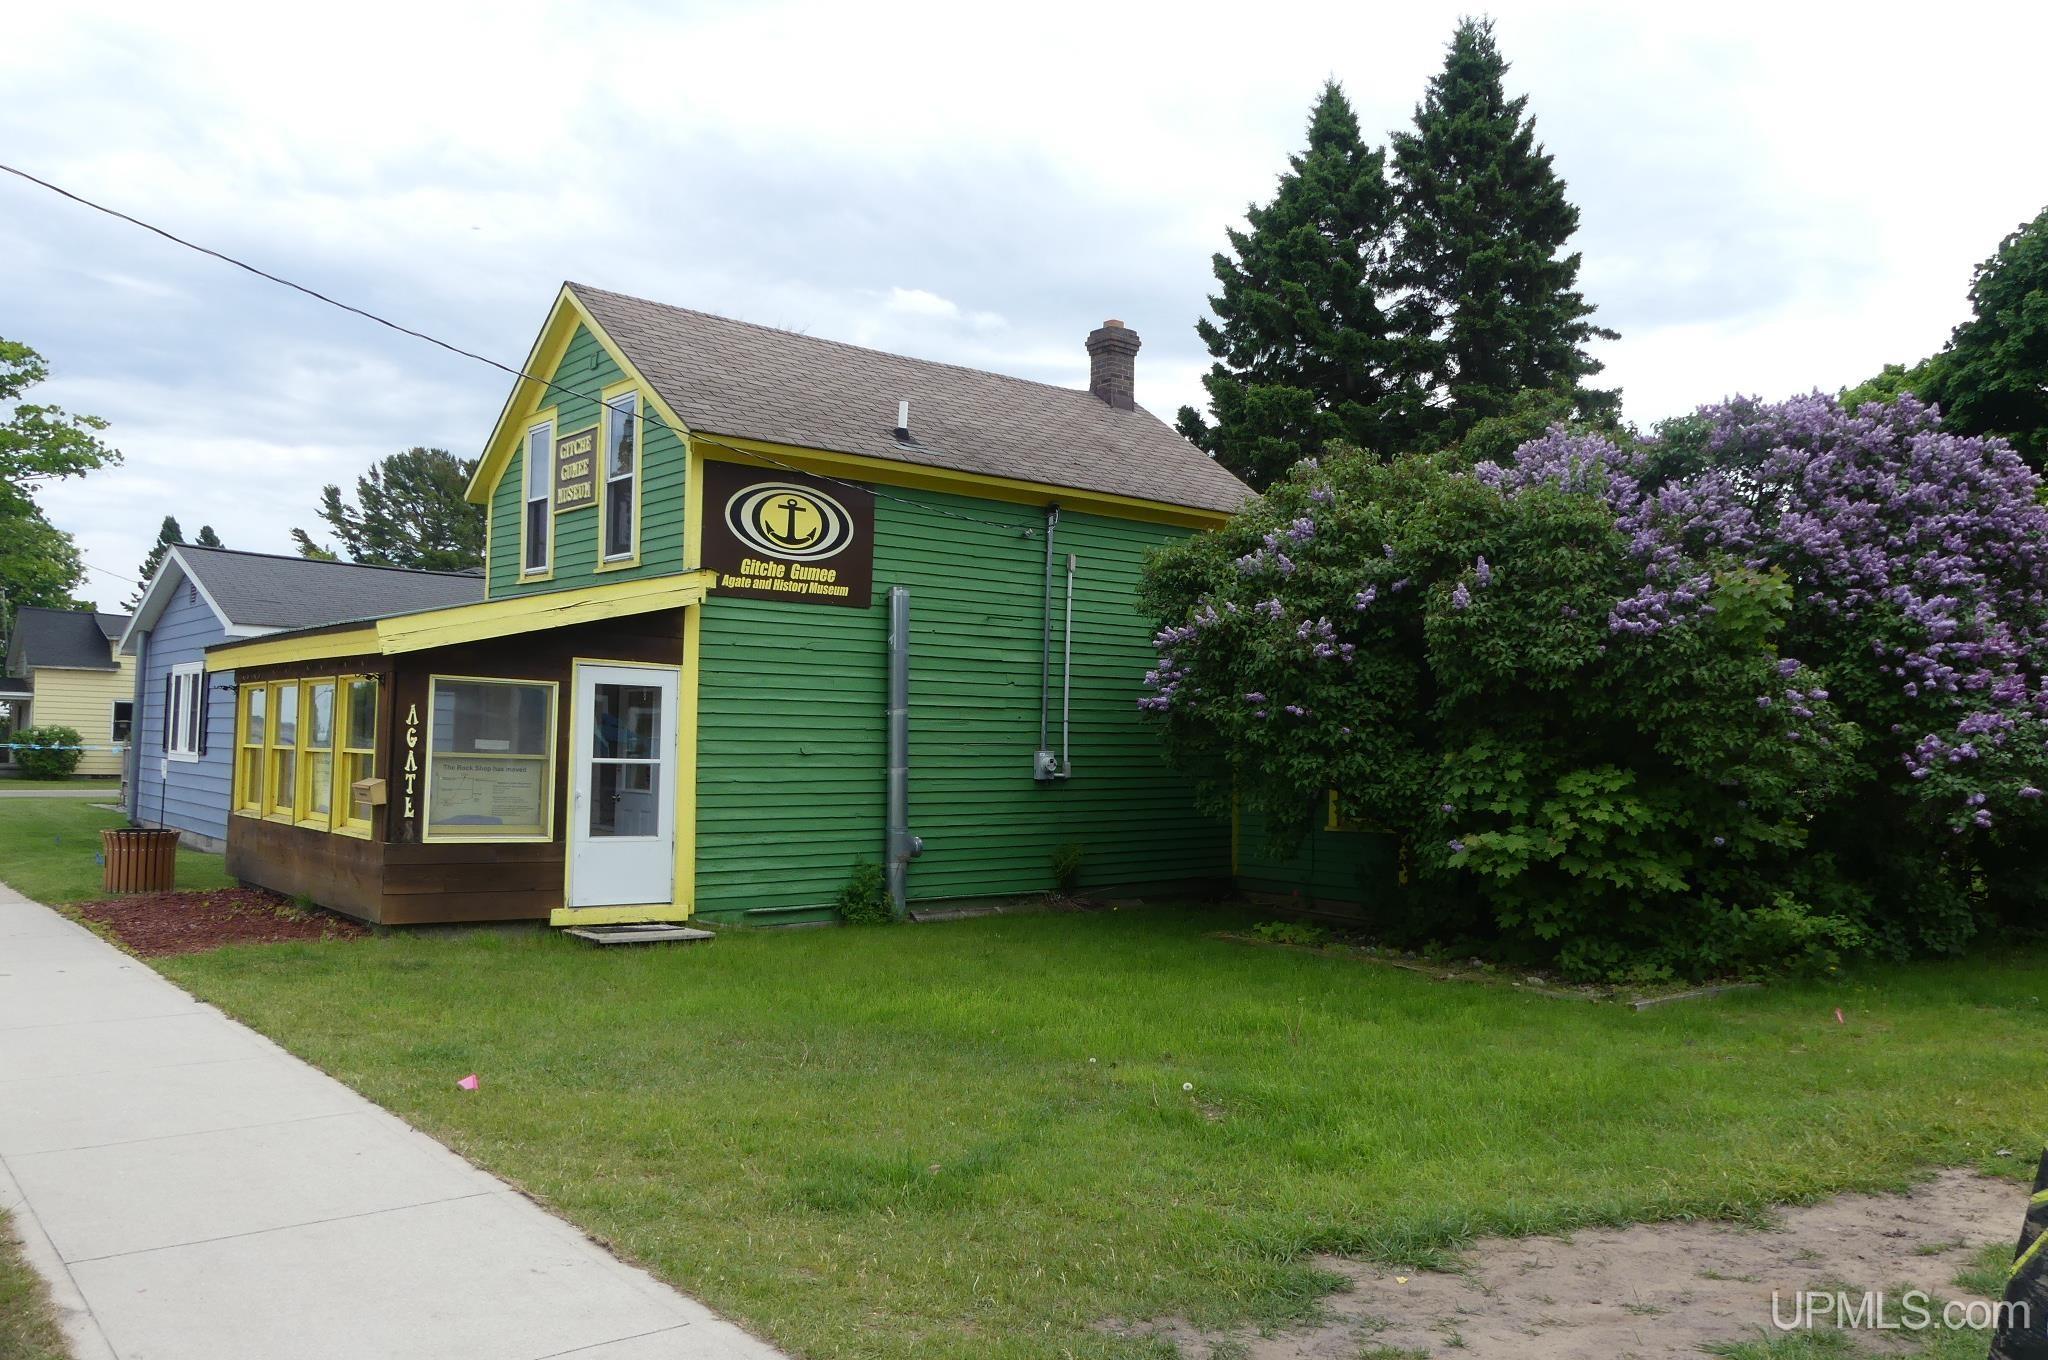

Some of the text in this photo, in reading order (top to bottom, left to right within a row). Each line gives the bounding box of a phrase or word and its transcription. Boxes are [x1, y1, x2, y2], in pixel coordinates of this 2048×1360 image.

[557, 481, 592, 504] MUSEUM
[741, 558, 837, 583] Gitche Gumee
[721, 574, 849, 597] Agate and History Museum
[443, 763, 455, 771] The
[475, 765, 491, 773] Shop
